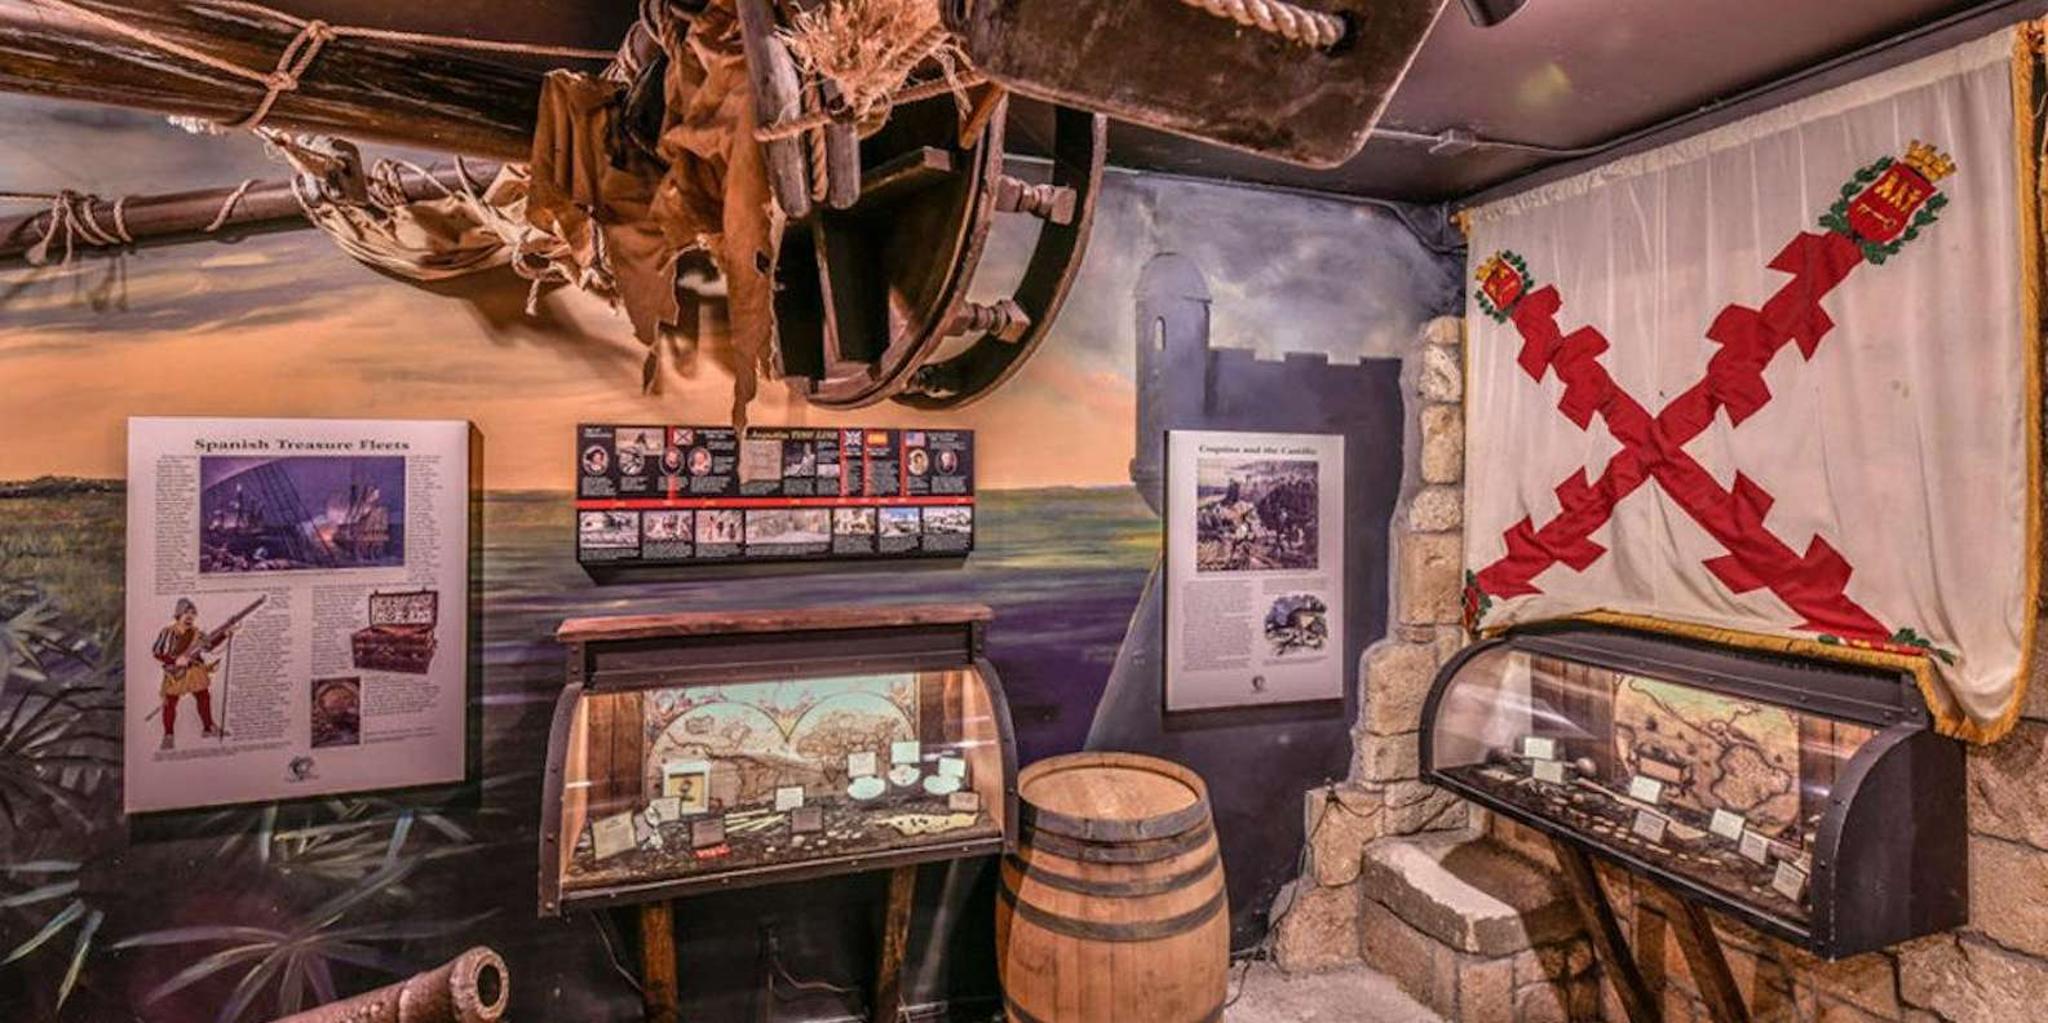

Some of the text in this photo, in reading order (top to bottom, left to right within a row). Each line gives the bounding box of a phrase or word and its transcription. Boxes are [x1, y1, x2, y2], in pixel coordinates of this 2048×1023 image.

[194, 438, 410, 452] Spanish Treasure Fleets
[1243, 446, 1260, 454] and
[1263, 446, 1278, 455] the
